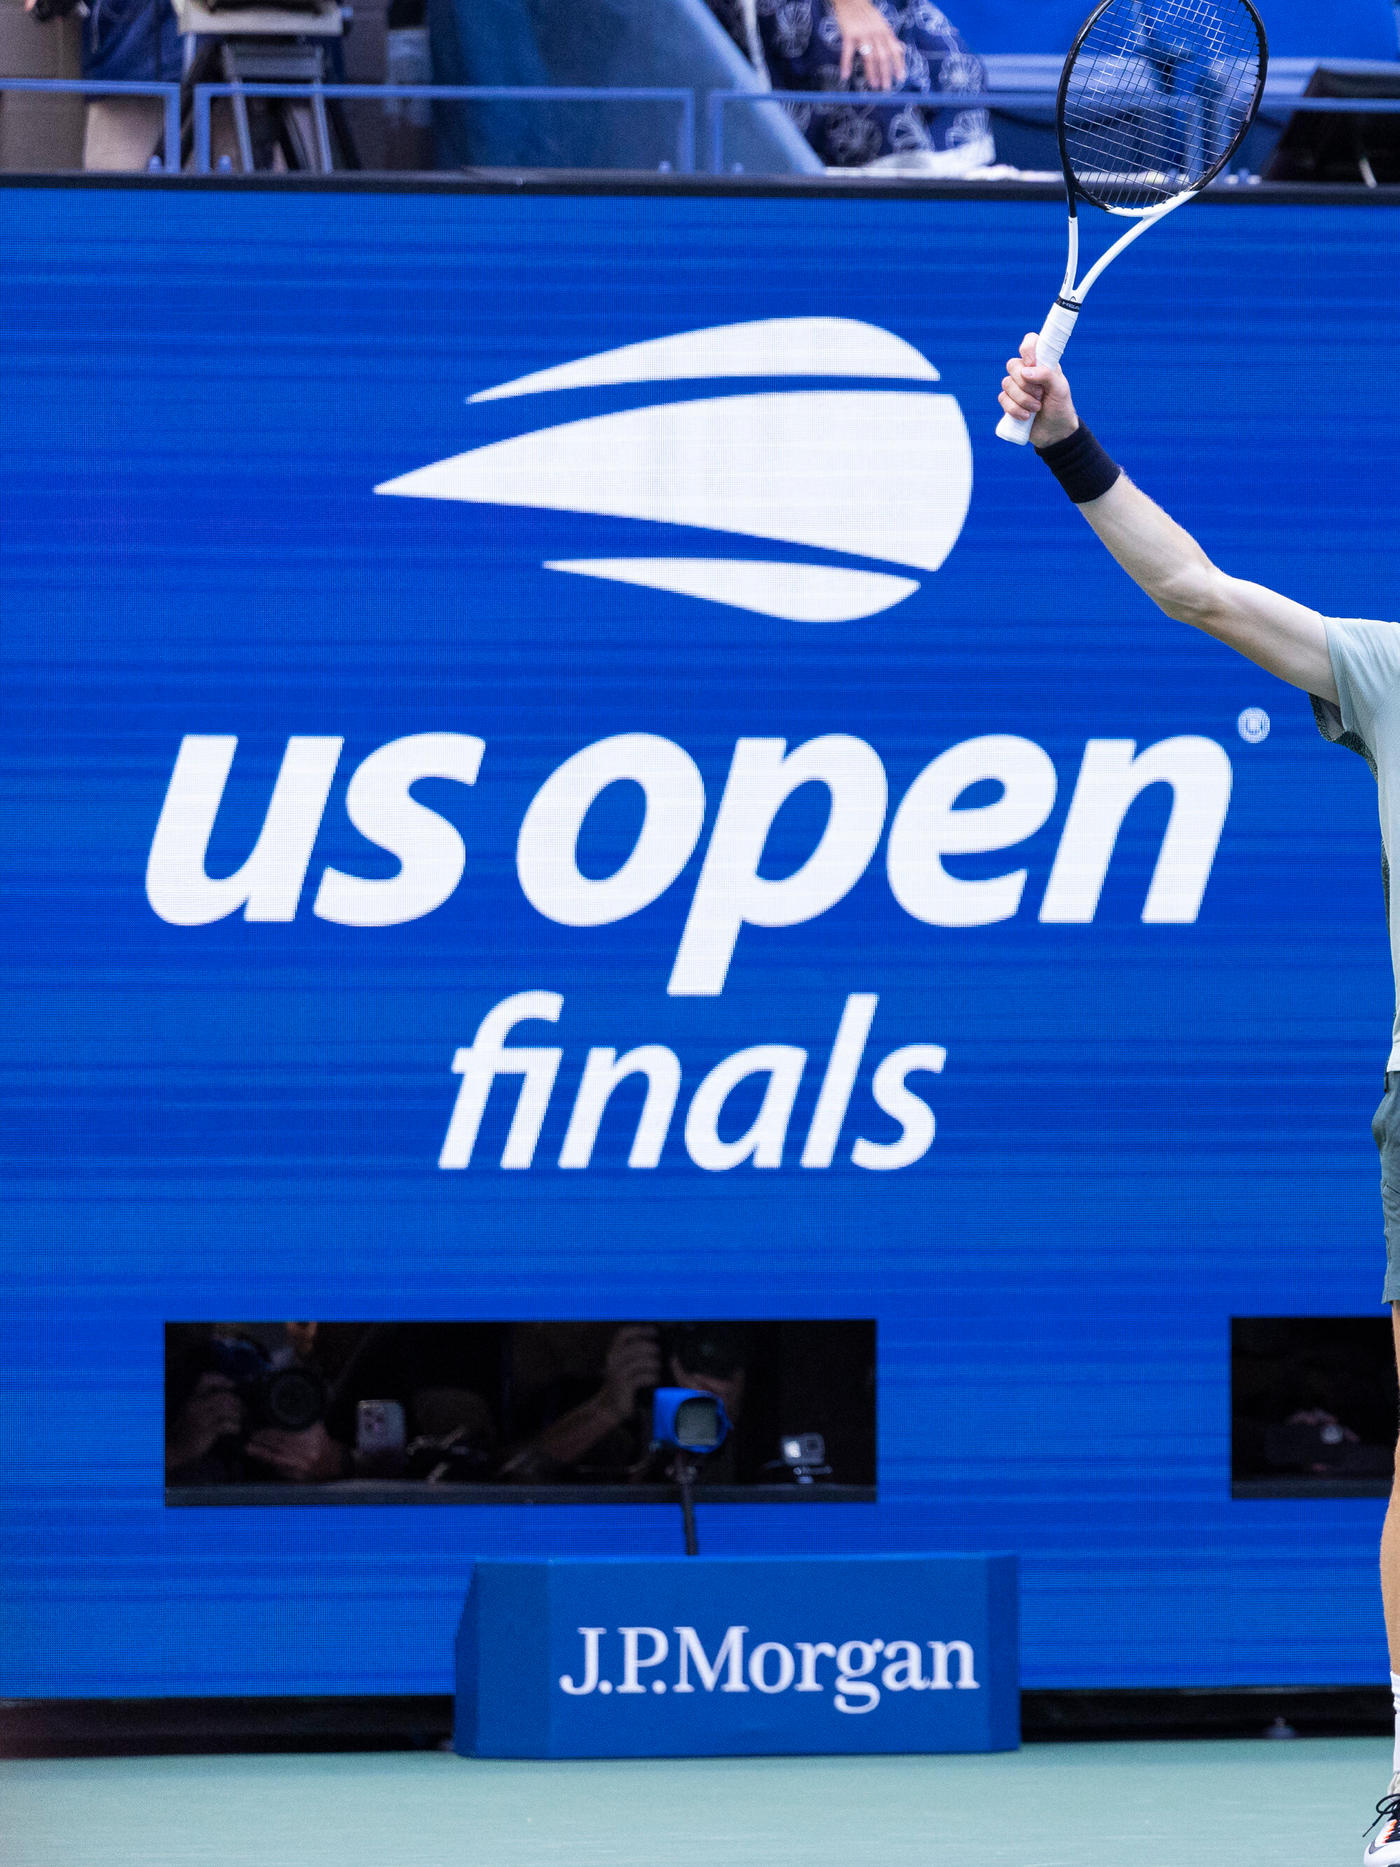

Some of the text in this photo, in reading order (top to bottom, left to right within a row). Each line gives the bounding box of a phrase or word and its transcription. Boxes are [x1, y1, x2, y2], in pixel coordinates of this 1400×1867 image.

[145, 732, 486, 927] us
[438, 990, 947, 1172] finals
[559, 1626, 979, 1714] J.P.Morgan
